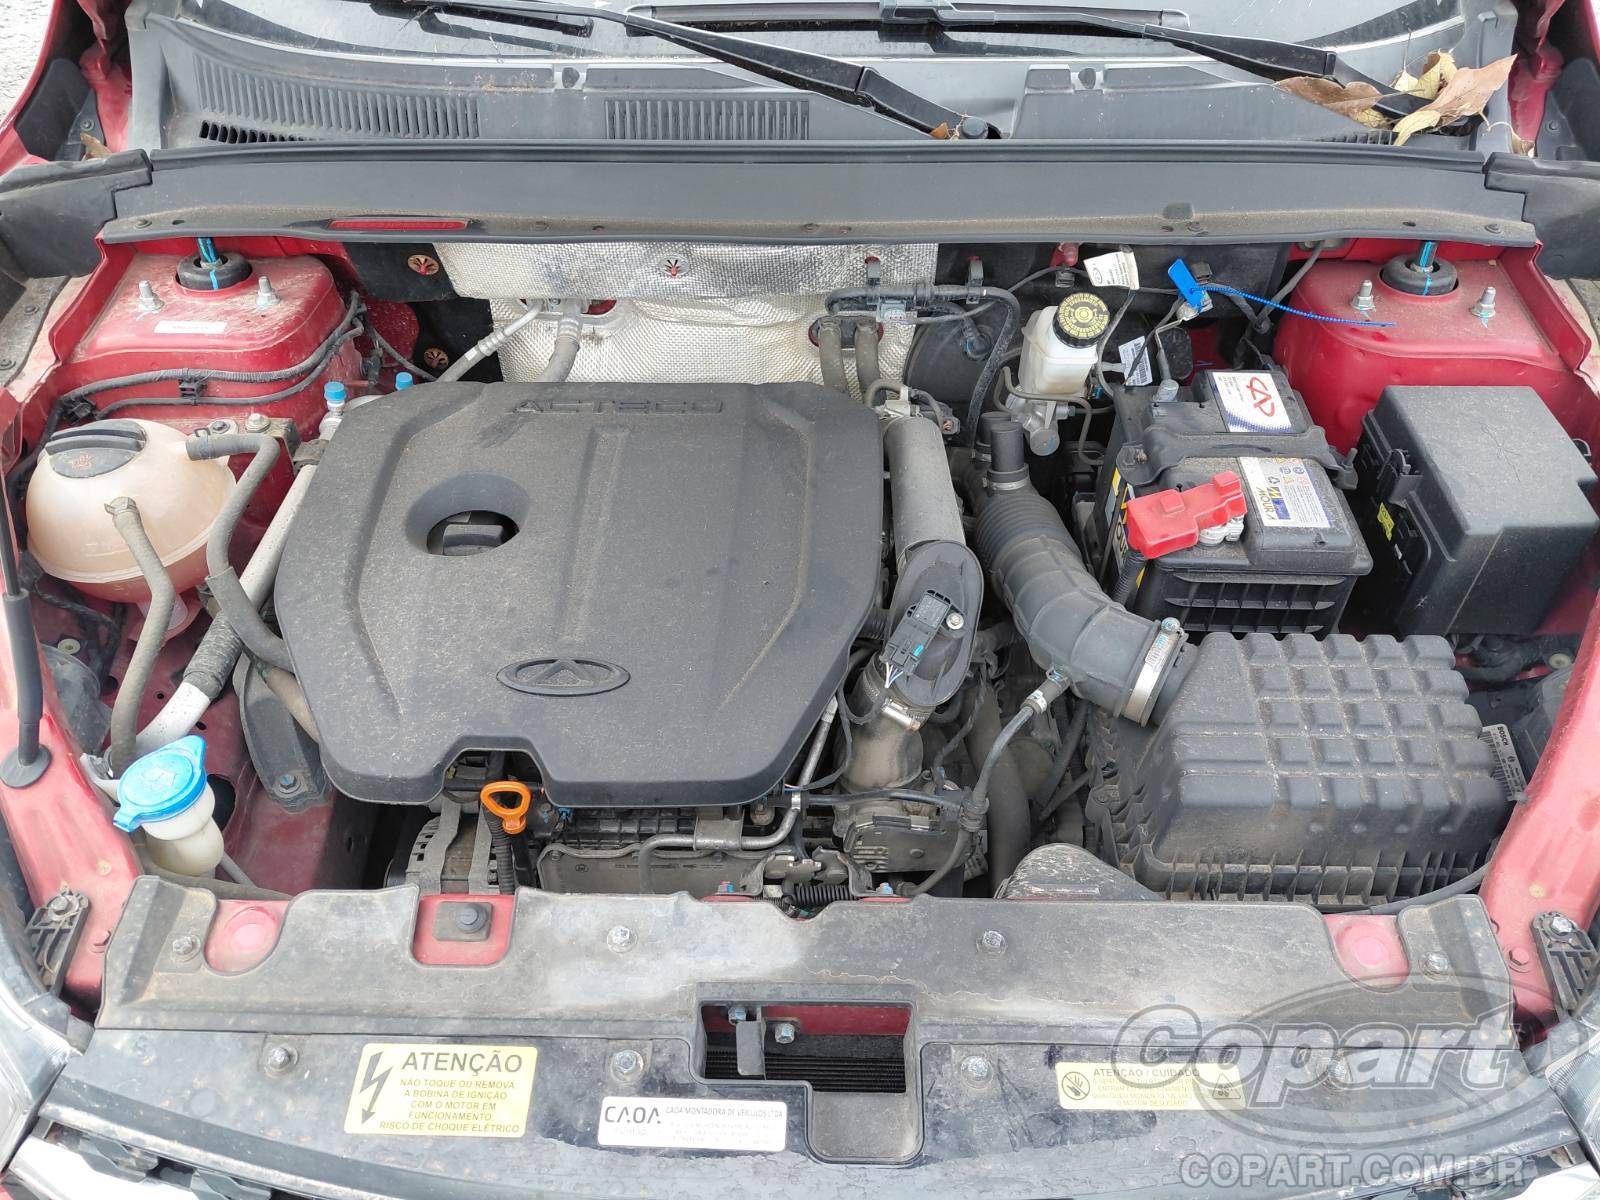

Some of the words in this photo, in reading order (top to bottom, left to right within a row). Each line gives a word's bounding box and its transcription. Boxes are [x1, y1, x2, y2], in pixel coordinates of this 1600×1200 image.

[1497, 726, 1509, 746] BOSCH
[401, 1050, 523, 1077] ATENÇÃO
[424, 1079, 456, 1088] TOQUE
[458, 1080, 473, 1088] OU
[475, 1080, 515, 1089] REMOVA
[403, 1089, 411, 1097] A
[413, 1089, 449, 1098] BOBINA
[452, 1090, 465, 1098] DE
[467, 1090, 508, 1101] IGNIÇÃO
[410, 1100, 433, 1109] COM
[435, 1101, 443, 1109] O
[445, 1101, 479, 1110] MOTOR
[482, 1102, 497, 1111] EM
[604, 1105, 662, 1125] CAOA
[379, 1121, 410, 1130] RISCO
[411, 1121, 425, 1130] DE
[427, 1122, 470, 1131] CHOQUE
